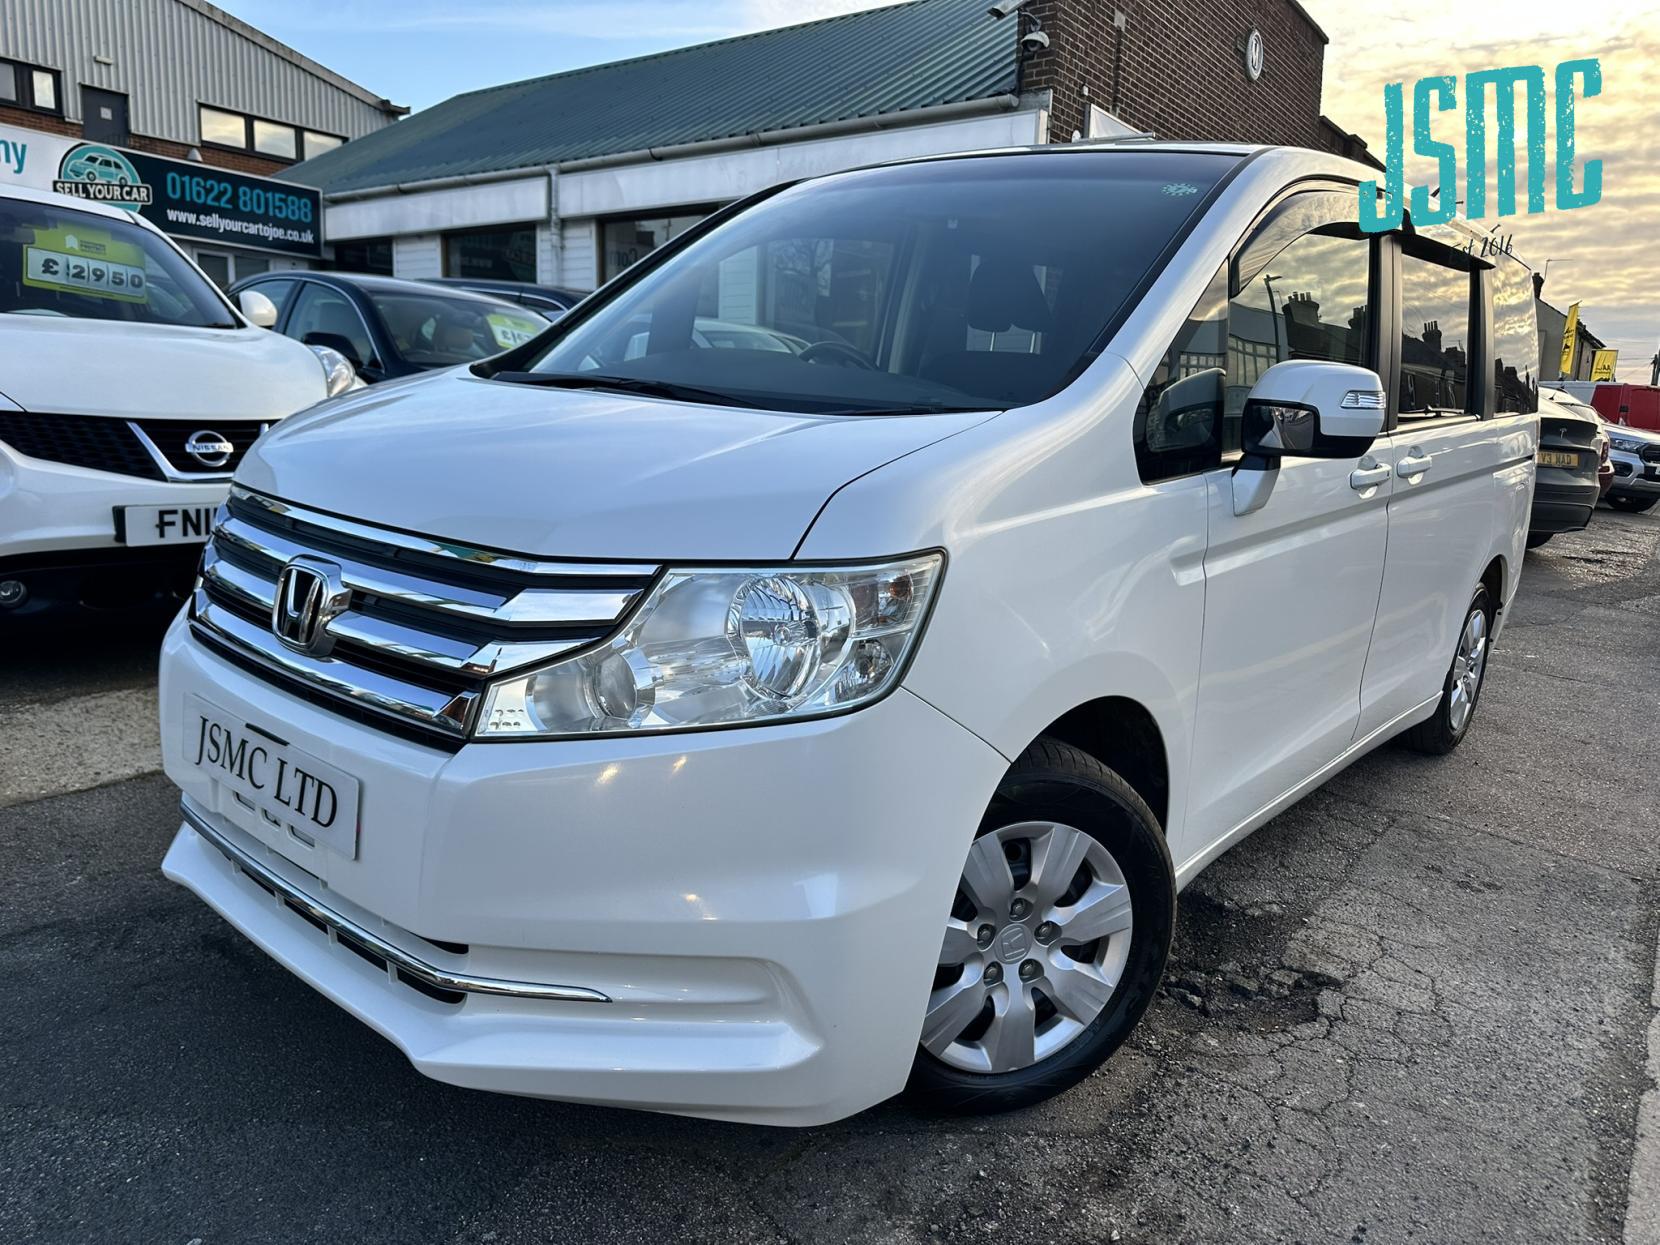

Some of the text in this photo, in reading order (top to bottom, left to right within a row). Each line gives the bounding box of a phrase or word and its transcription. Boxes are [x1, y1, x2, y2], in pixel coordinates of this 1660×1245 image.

[56, 182, 148, 202] SELL YOUR CAR
[166, 171, 313, 223] 01622 801588
[166, 208, 314, 244] www.sellyourcartojoe.co.uk
[194, 715, 338, 829] JSMC LTD
